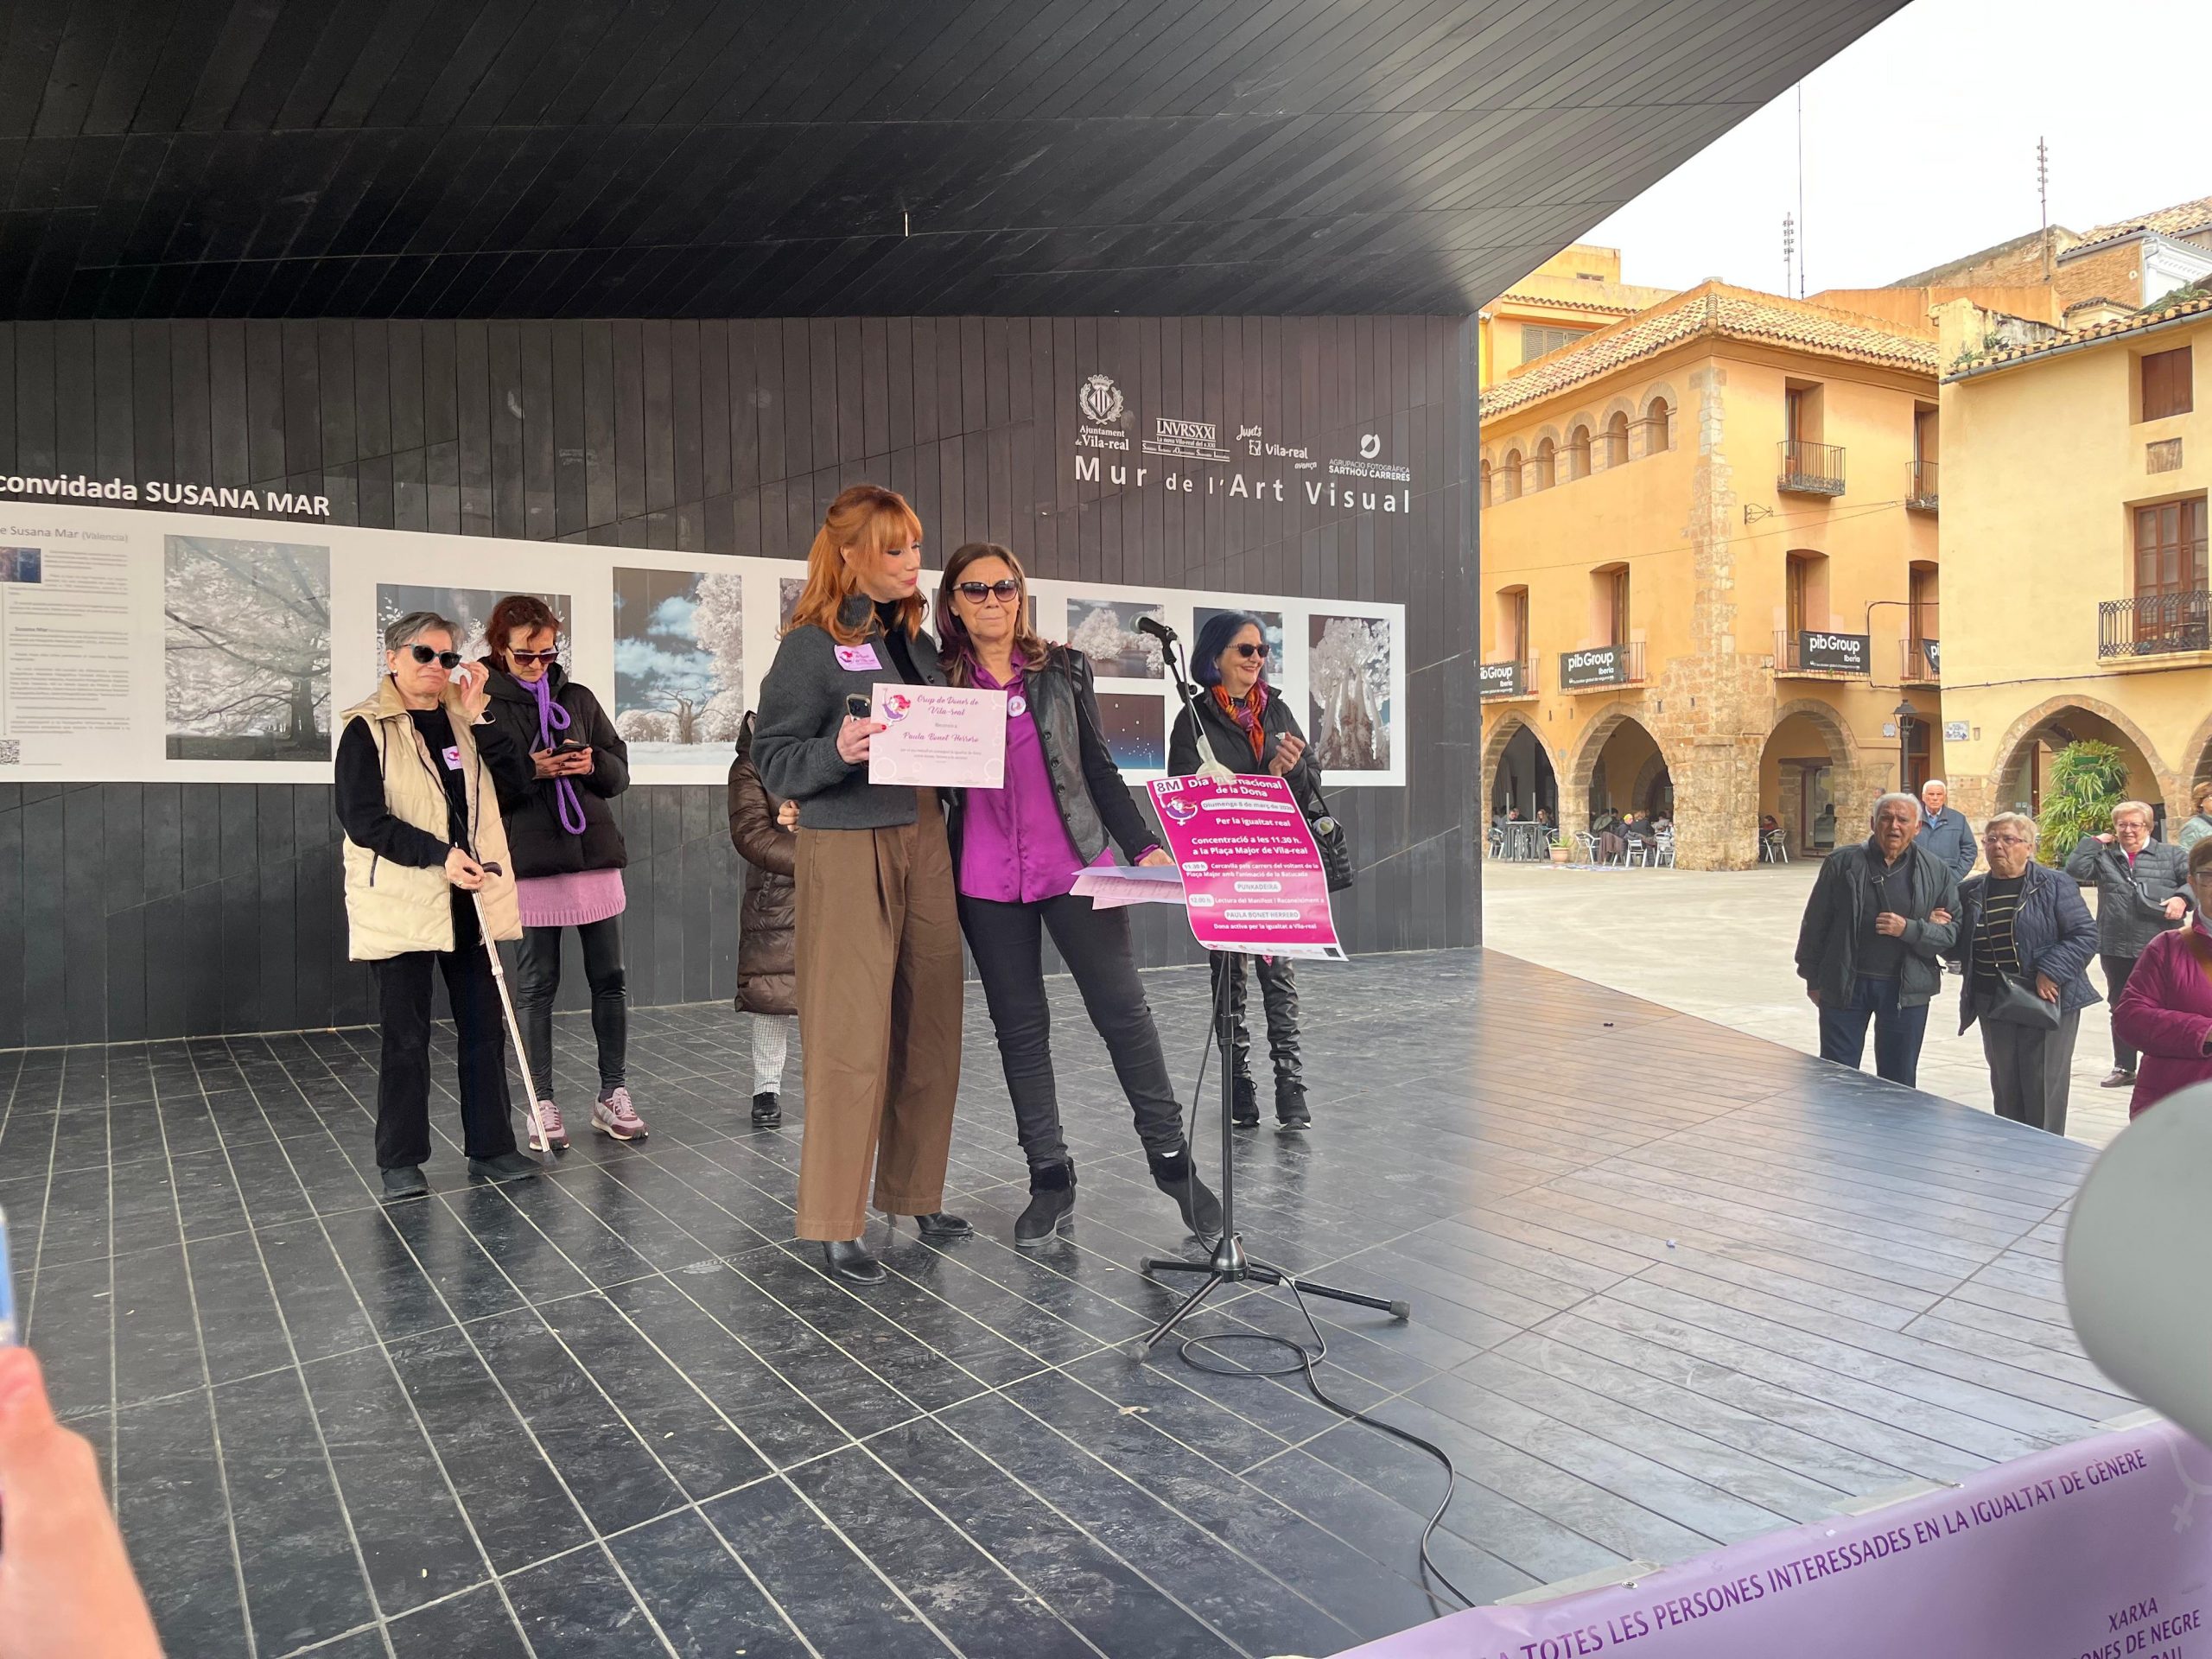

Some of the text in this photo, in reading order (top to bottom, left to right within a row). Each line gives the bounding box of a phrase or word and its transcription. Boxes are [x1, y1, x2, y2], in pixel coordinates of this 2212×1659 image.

[1079, 424, 1125, 437] Ajuntament
[1157, 420, 1216, 440] LNVRSXXI
[1082, 434, 1129, 450] Vila-real
[1265, 443, 1308, 459] Vila-real
[1294, 461, 1318, 470] avança
[1329, 465, 1411, 482] SARTHOU CARRERES
[1074, 454, 1147, 486] Mur
[1166, 472, 1194, 493] de
[1305, 480, 1410, 513] Visual
[145, 481, 260, 511] SUSANA
[267, 492, 331, 517] MAR
[10, 525, 52, 537] Susana
[54, 528, 79, 538] Mar
[82, 531, 129, 544] (Valencia)
[1843, 654, 1860, 663] Iberia
[1599, 666, 1614, 676] Iberia
[928, 705, 965, 715] Vila-real
[903, 732, 925, 741] Paula
[1157, 780, 1180, 793] 8M
[1187, 779, 1210, 788] Dia
[1230, 785, 1238, 794] la
[1241, 786, 1268, 798] Dona
[1203, 800, 1238, 809] Diumenge
[1231, 817, 1241, 825] la
[1242, 817, 1274, 827] igualtat
[1192, 836, 1249, 845] Concentració
[1200, 847, 1209, 855] la
[1211, 847, 1233, 857] Plaça
[1235, 847, 1260, 857] Major
[1262, 846, 1272, 855] de
[1273, 846, 1308, 855] Vila-real
[1520, 1448, 2148, 1659] TOTES LES PERSONES INTERESSADES EN LA IGUALTAT DE GÈNERE
[2108, 1597, 2158, 1634] XARXA
[2126, 1630, 2147, 1655] DE
[2151, 1609, 2201, 1644] NEGRE
